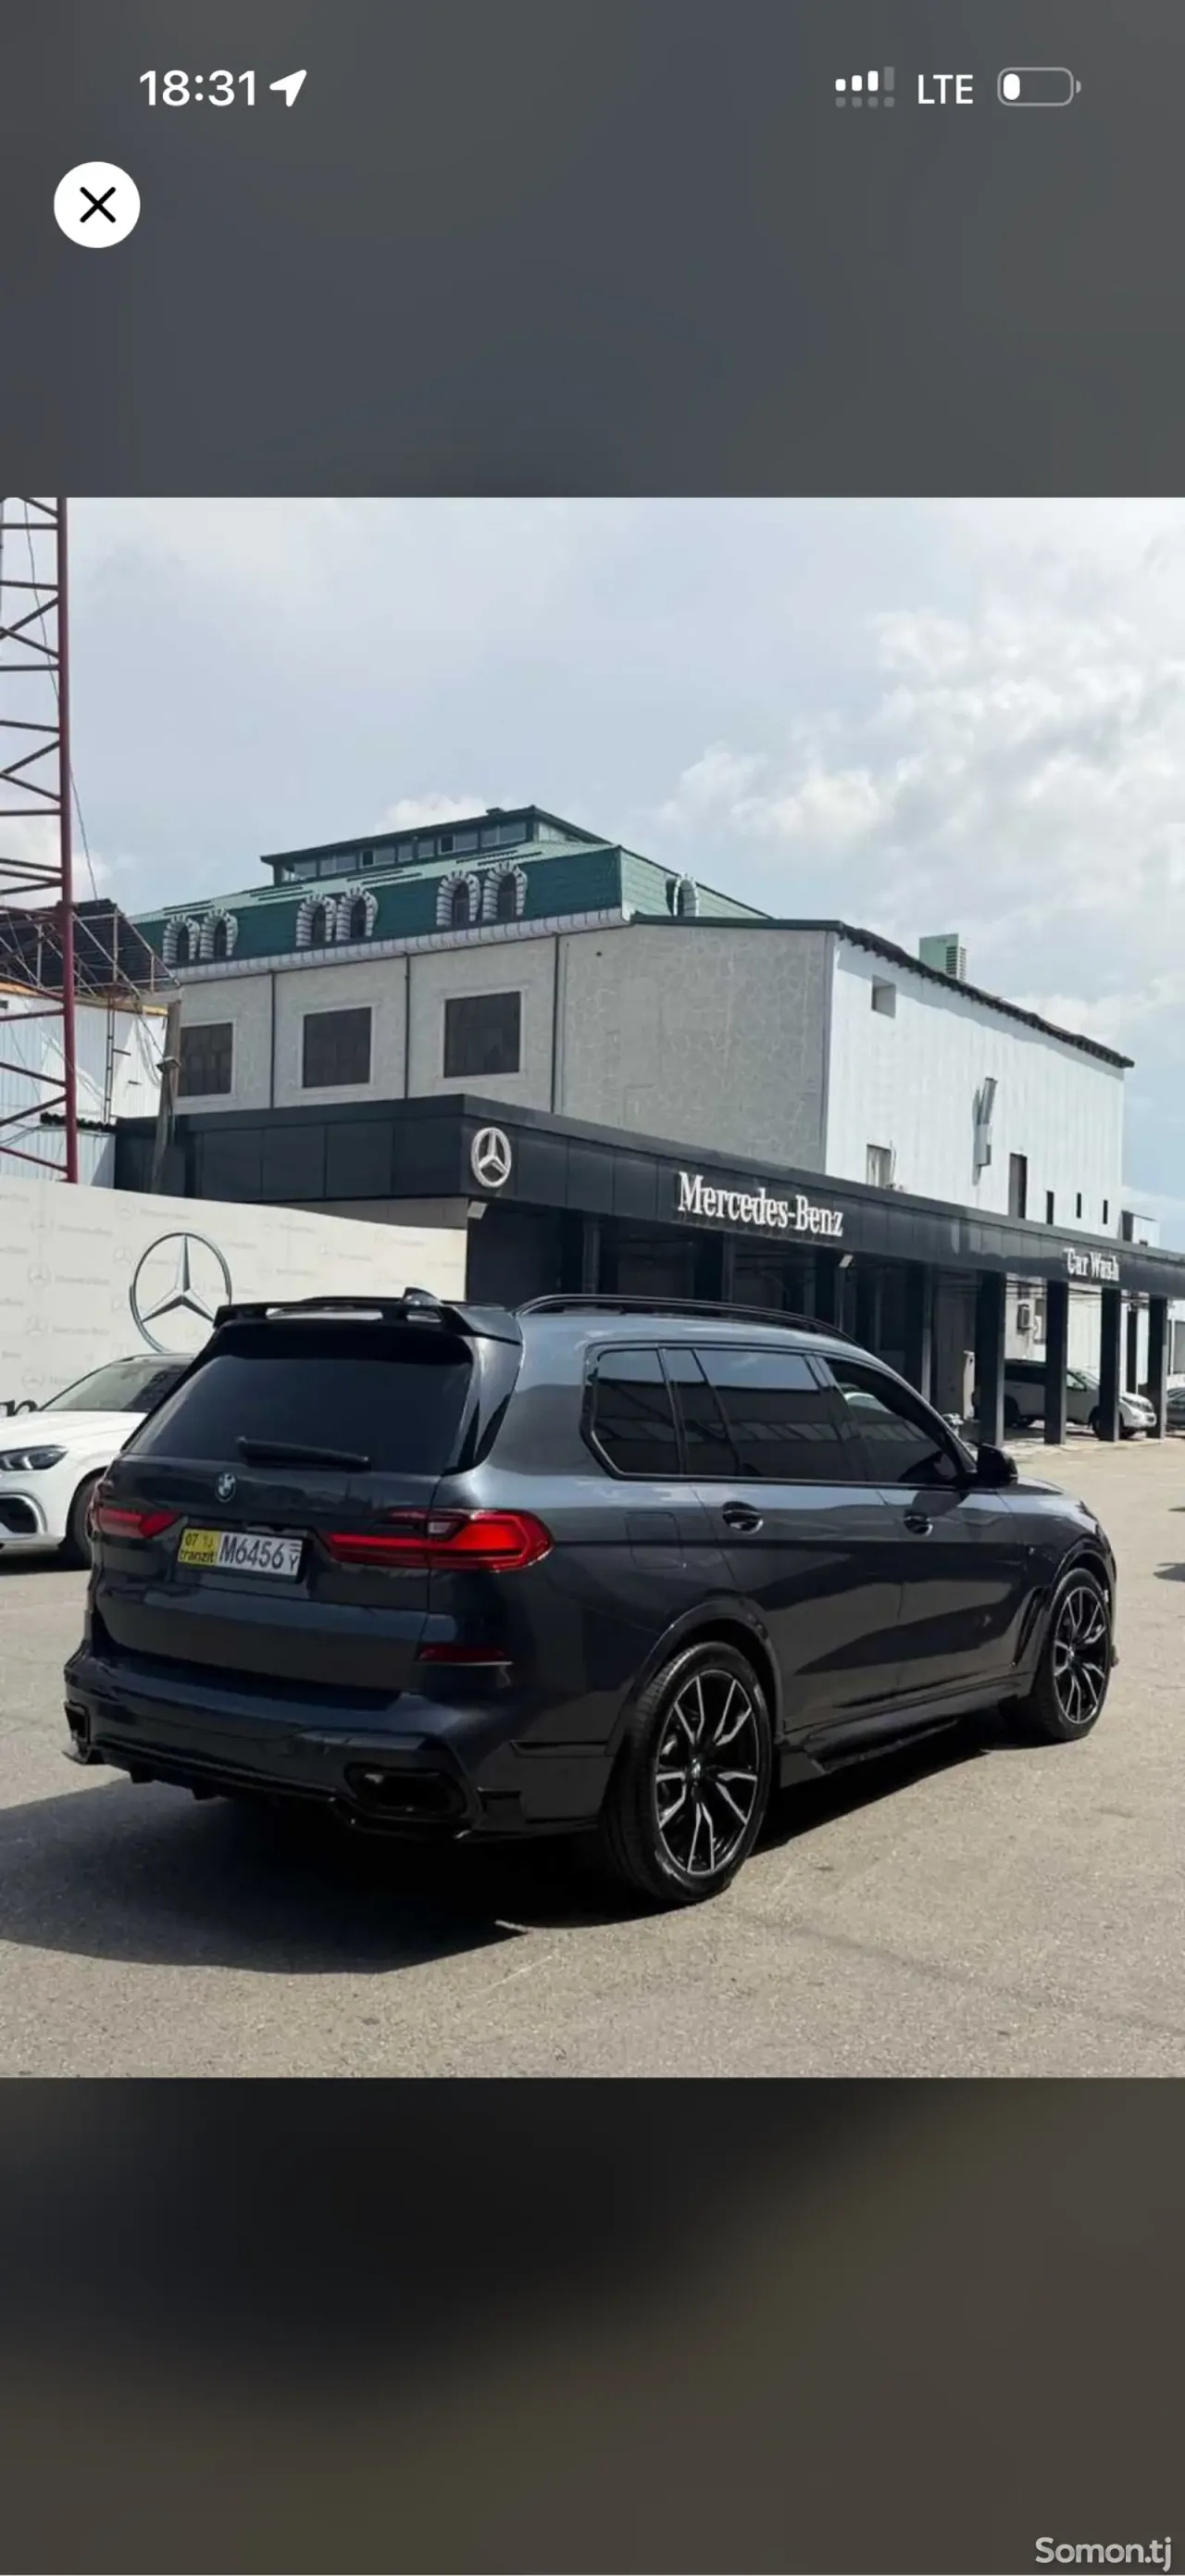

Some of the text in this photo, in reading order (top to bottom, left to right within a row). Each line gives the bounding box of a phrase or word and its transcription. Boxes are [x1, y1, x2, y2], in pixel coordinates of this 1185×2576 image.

[677, 1170, 844, 1238] Mercedes-Benz
[1065, 1246, 1089, 1276] Car
[184, 1532, 199, 1547] 07
[219, 1534, 284, 1570] M6456
